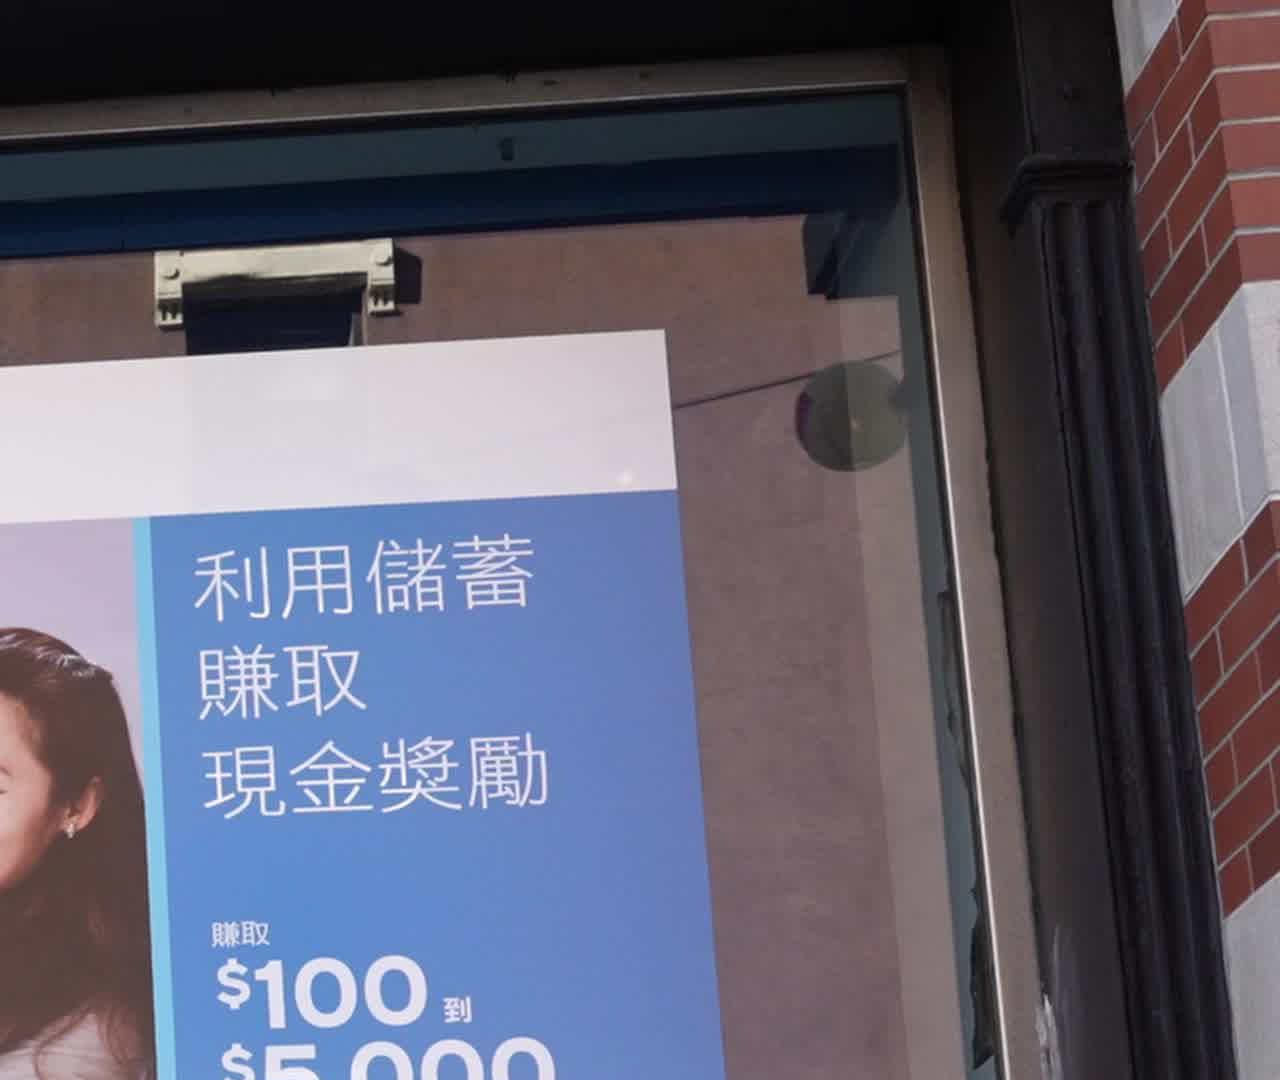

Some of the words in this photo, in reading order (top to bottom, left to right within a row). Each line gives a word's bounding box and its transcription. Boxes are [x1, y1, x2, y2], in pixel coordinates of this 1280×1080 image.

[195, 534, 533, 622] 利用儲蓄
[200, 644, 366, 720] 賺取
[202, 733, 547, 819] 現金獎勵
[212, 921, 270, 947] 賺取
[217, 955, 427, 1029] $100
[444, 997, 472, 1023] 到
